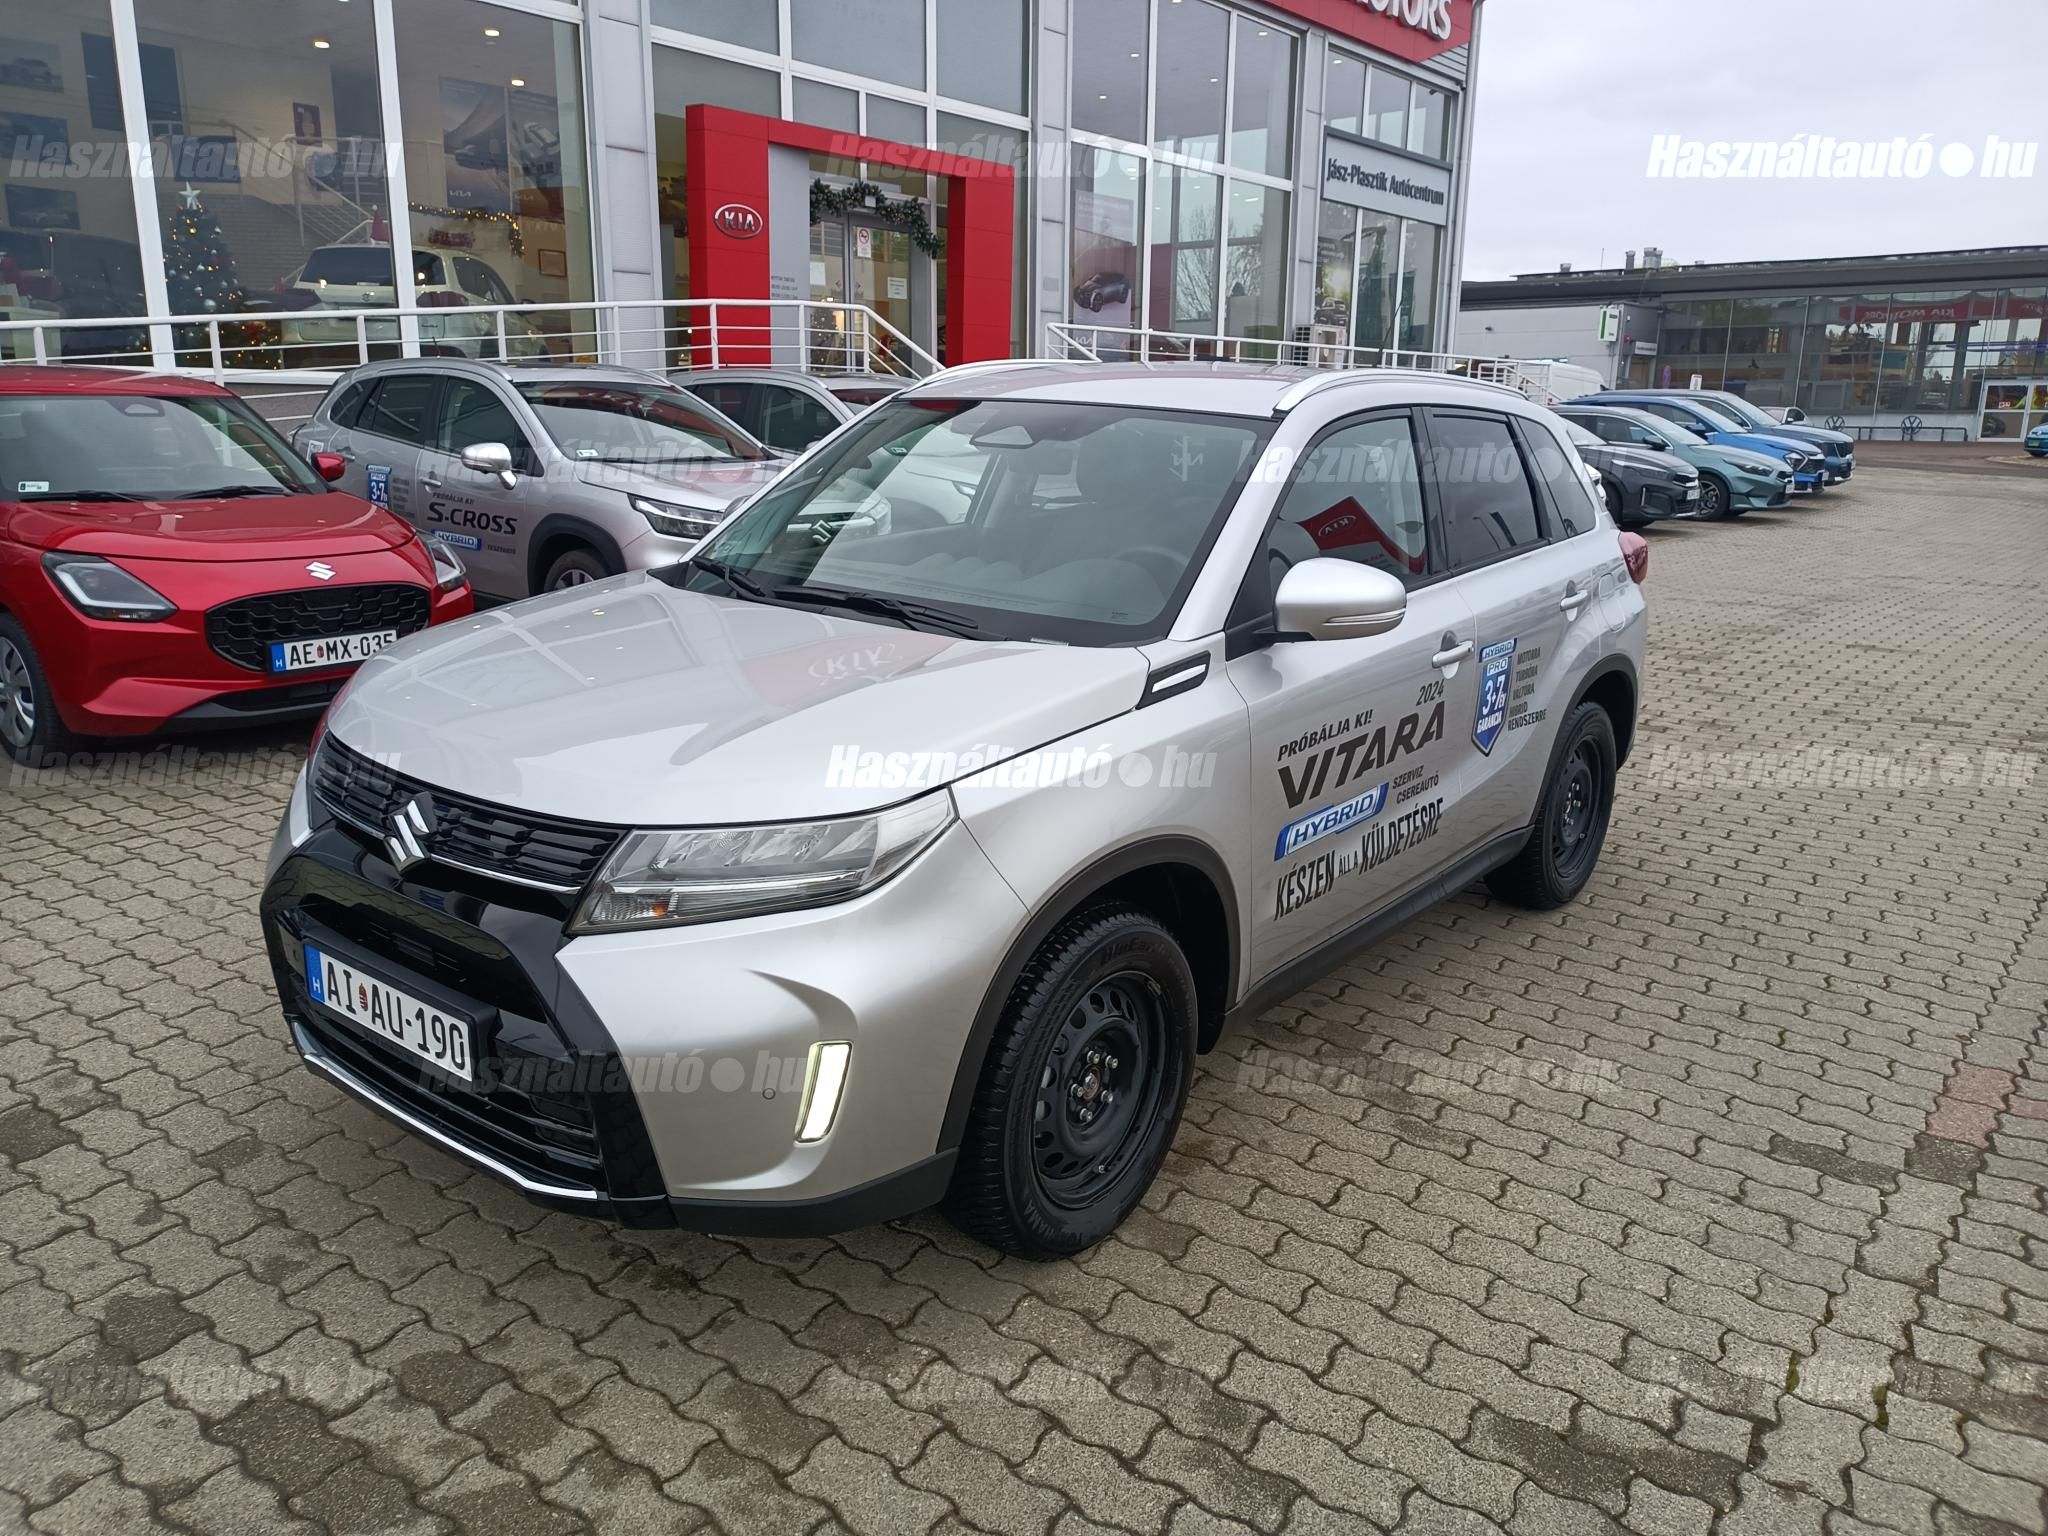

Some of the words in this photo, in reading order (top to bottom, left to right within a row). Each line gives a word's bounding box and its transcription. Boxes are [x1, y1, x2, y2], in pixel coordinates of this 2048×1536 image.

[1326, 158, 1388, 192] Jász-Plasztik
[1389, 175, 1444, 205] Autócentrum
[724, 210, 755, 232] KIA
[438, 532, 475, 546] HYBRID
[1484, 641, 1513, 659] HYBRID
[1489, 661, 1507, 674] PRO
[1415, 679, 1445, 706] 2024
[1507, 708, 1547, 731] RENDSZERRE
[1277, 718, 1350, 762] PRÓBÁLJA
[1354, 709, 1373, 729] KI!
[1277, 701, 1445, 809] VITARA
[1392, 765, 1424, 790] SZERVIZ
[1396, 770, 1439, 804] CSEREAUTÓ
[1292, 793, 1374, 847] HYBRID
[1274, 850, 1336, 921] KÉSZEN
[1358, 797, 1443, 876] KÜLDETÉSRE
[313, 977, 321, 994] H
